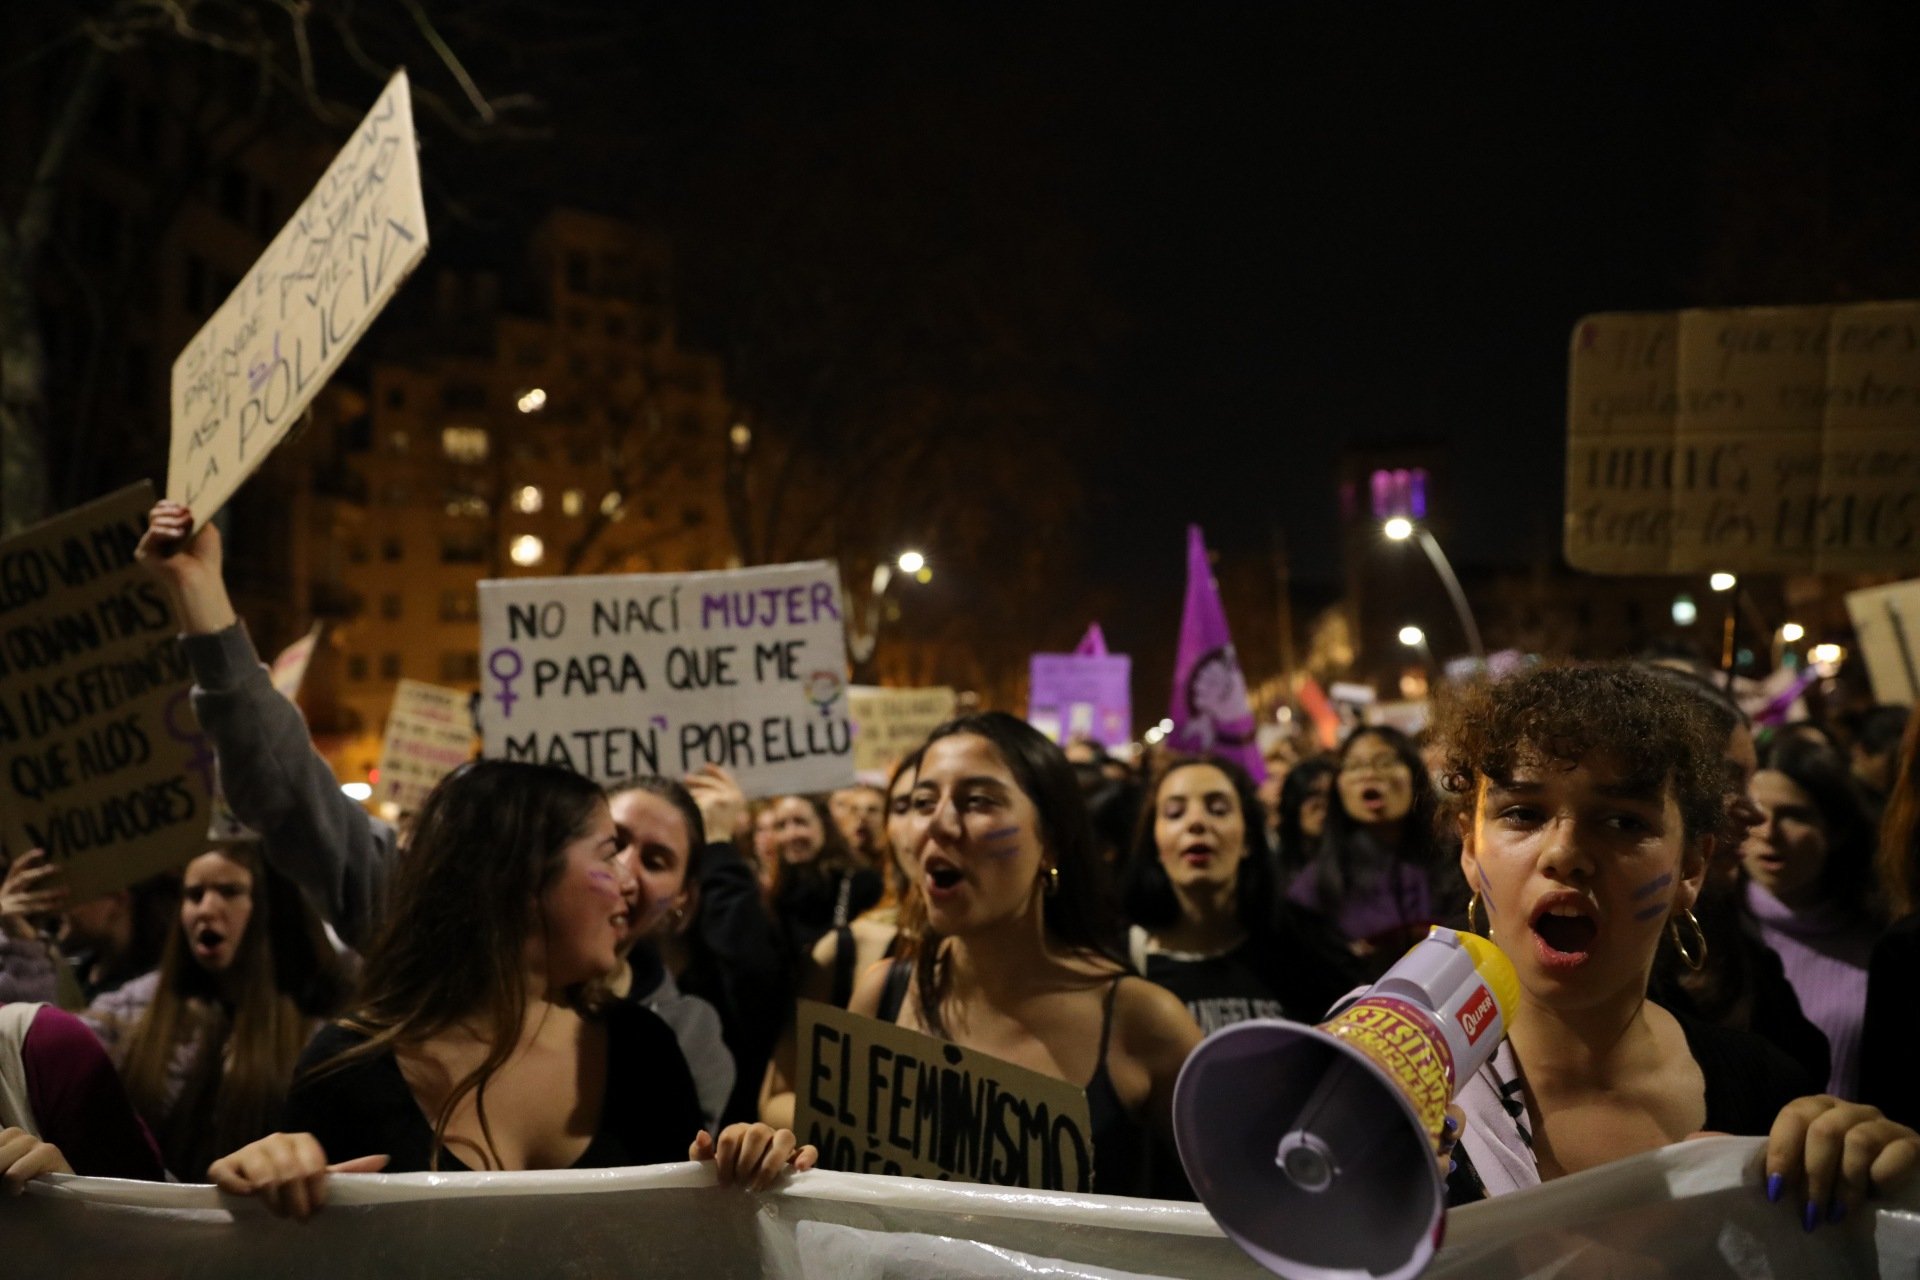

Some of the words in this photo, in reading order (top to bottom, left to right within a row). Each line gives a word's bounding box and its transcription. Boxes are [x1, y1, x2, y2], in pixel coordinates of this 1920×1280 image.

[508, 602, 565, 640] NO
[592, 586, 682, 636] NACÍ
[702, 581, 841, 630] MUJER
[534, 654, 647, 697] PARA
[666, 645, 738, 691] QUE
[756, 640, 807, 682] ME
[11, 742, 72, 803] QUE
[506, 727, 659, 778] MATEN
[681, 720, 755, 771] POR
[809, 1022, 857, 1127] EL
[867, 1044, 1089, 1191] FEMINISMO
